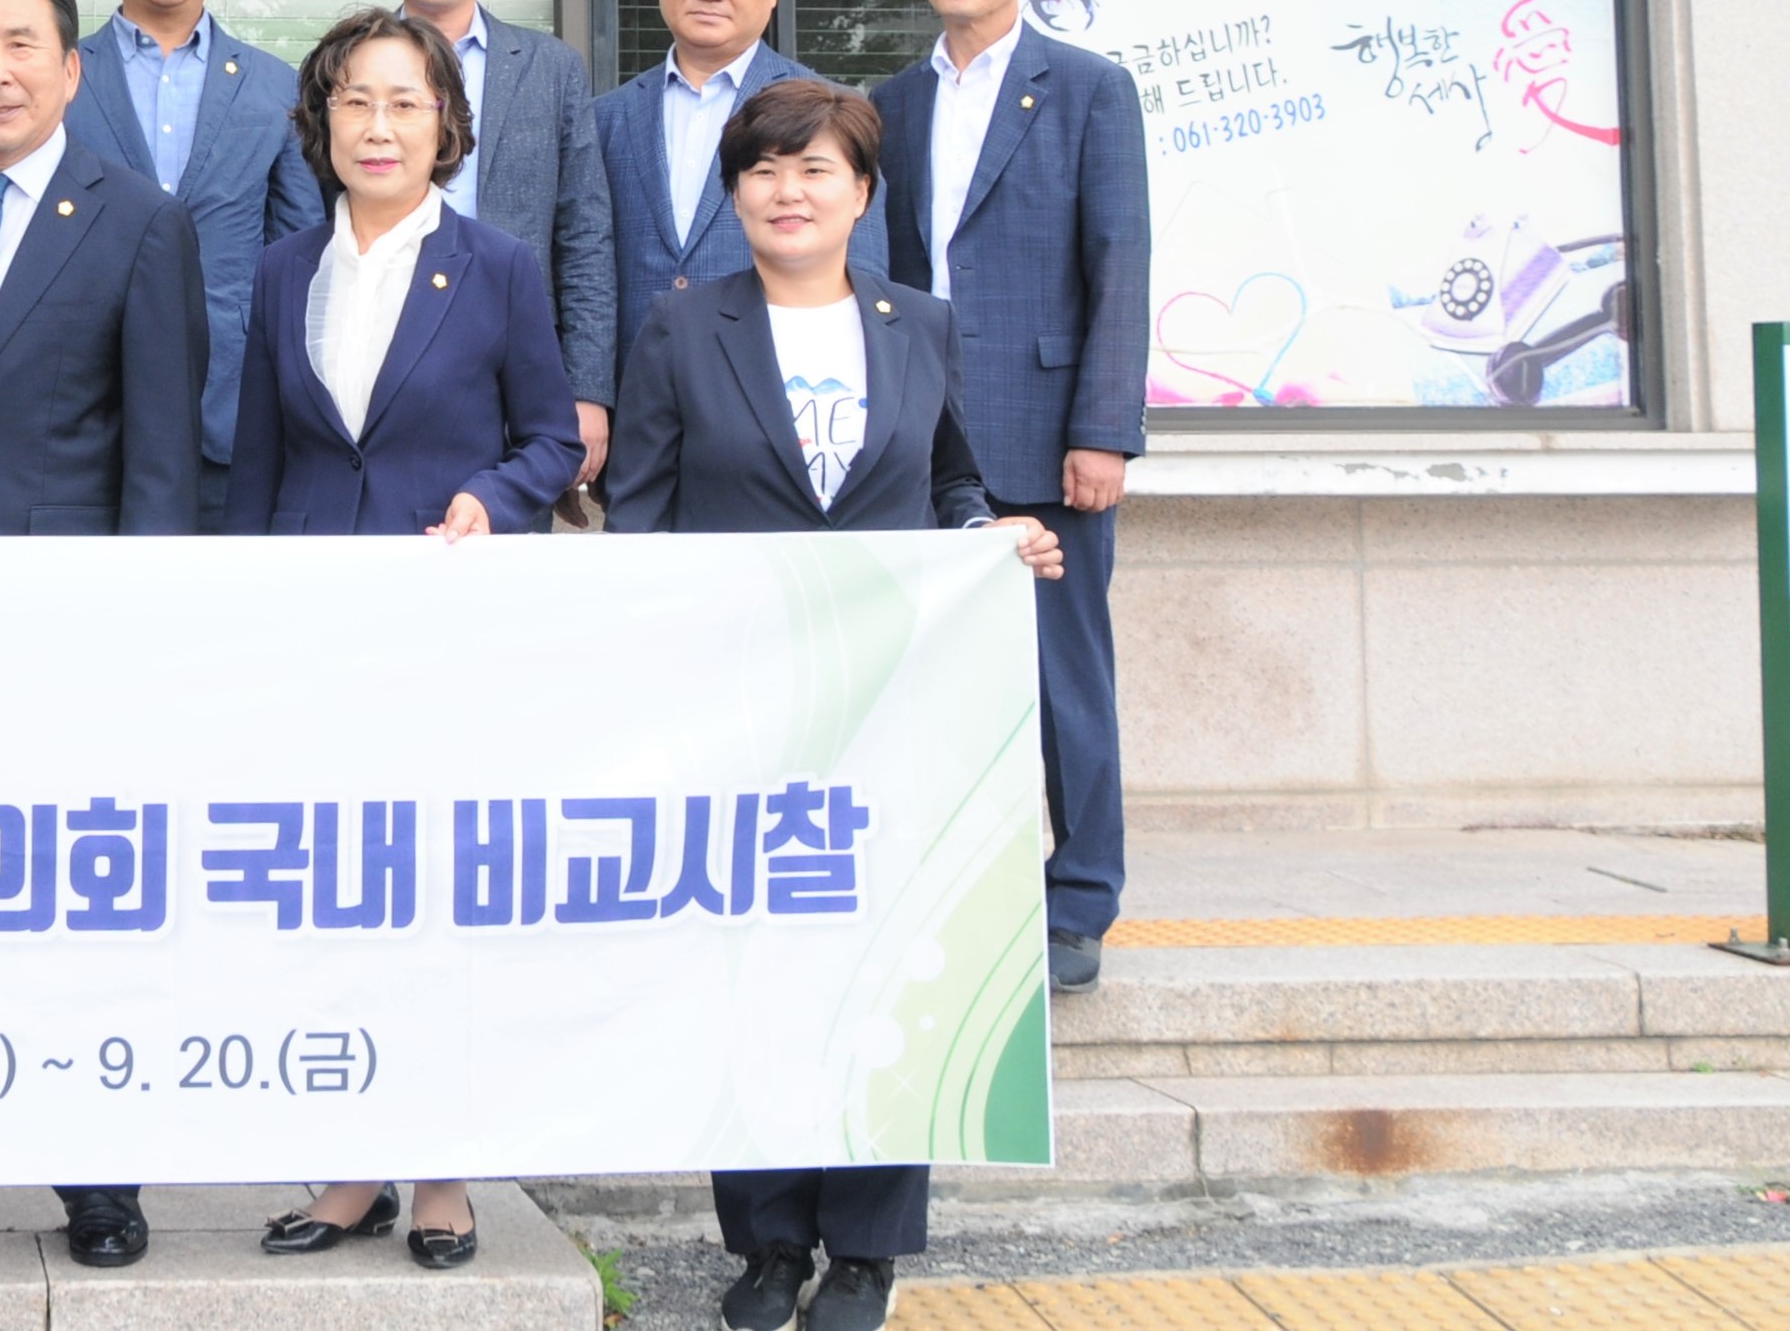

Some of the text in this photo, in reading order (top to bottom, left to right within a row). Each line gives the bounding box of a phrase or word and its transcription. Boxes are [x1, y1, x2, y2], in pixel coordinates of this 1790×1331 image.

[1175, 57, 1289, 108] 드립니다.
[1330, 16, 1460, 99] 행복한
[202, 801, 416, 930] 국내
[453, 781, 869, 927] 비교시찰
[98, 1036, 151, 1092] 9.
[178, 1027, 378, 1096] 20.(금)
